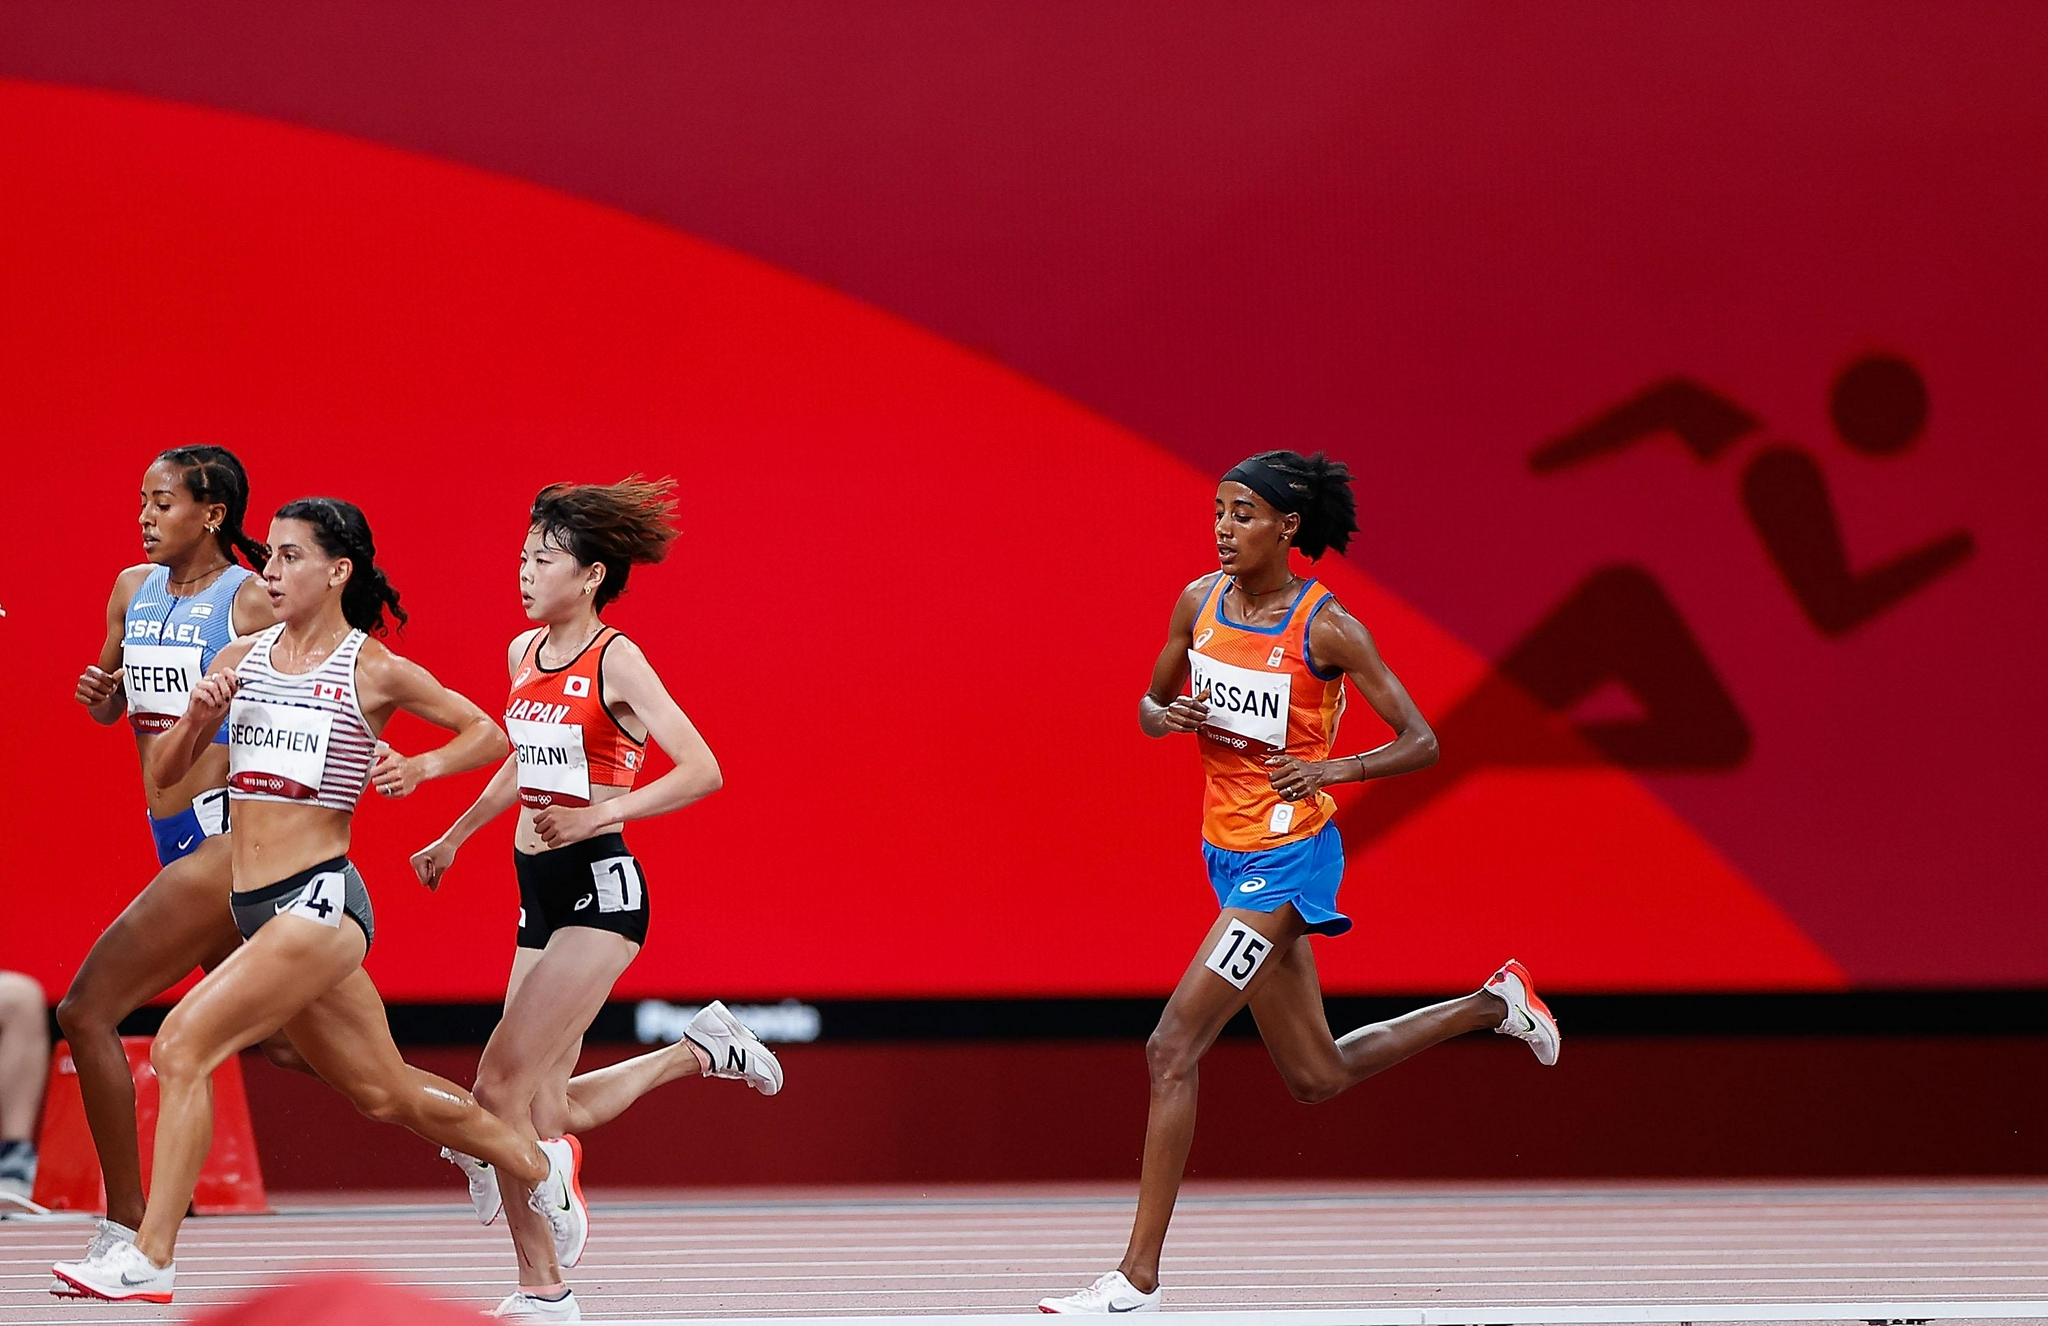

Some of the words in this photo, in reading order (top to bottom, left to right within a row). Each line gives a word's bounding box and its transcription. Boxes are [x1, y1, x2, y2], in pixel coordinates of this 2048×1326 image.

[126, 619, 208, 647] ISRAEL
[125, 663, 189, 693] TEFERI
[1194, 667, 1280, 719] HASSAN
[505, 697, 571, 724] JAPAN
[231, 723, 319, 754] SECCAFIEN
[516, 743, 568, 766] GITANI
[202, 788, 230, 834] 7
[305, 878, 334, 919] 4
[608, 861, 629, 906] 1
[1218, 929, 1266, 981] 15
[726, 1045, 747, 1073] N
